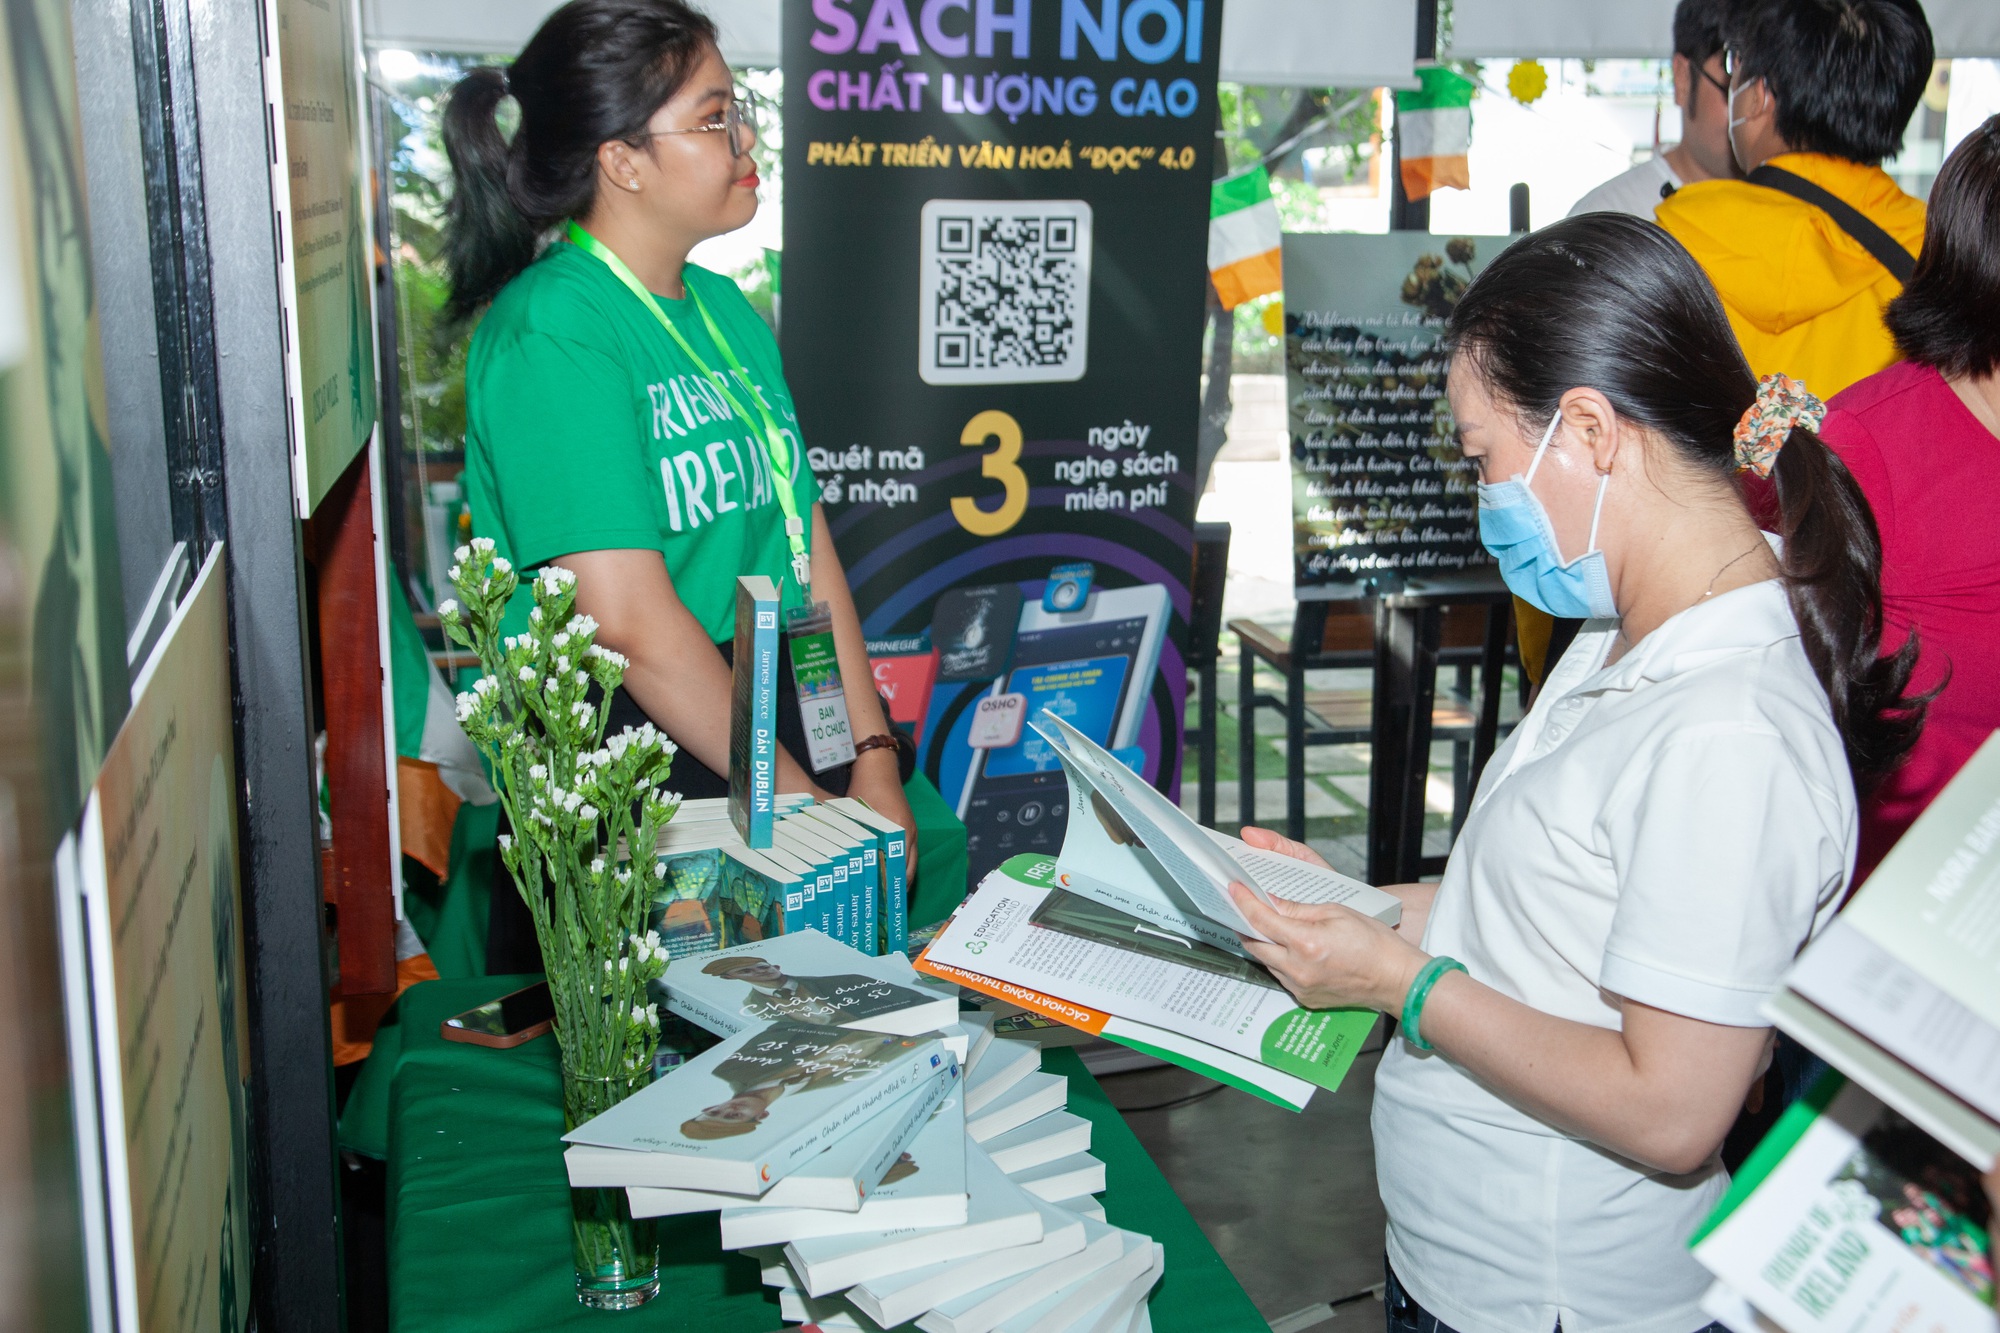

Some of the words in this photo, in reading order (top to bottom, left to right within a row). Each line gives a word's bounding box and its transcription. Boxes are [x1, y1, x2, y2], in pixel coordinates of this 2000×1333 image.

[807, 60, 929, 111] CHẤT
[942, 72, 1098, 123] LƯỢNG
[1110, 77, 1199, 117] CAO
[807, 136, 876, 166] PHÁT
[881, 135, 951, 167] TRIỂN
[958, 140, 1015, 169] VĂN
[1019, 140, 1073, 169] HOÁ
[1158, 146, 1196, 169] 4.0
[1088, 419, 1151, 452] ngày
[807, 445, 872, 472] Quét
[878, 447, 924, 471] mã
[950, 410, 1029, 537] 3
[1055, 457, 1116, 484] nghe
[1122, 450, 1178, 475] sách
[848, 477, 918, 508] nhận
[1065, 481, 1124, 511] miễn
[1130, 480, 1167, 511] phí
[865, 637, 921, 652] ARNEGIE
[762, 648, 772, 685] James
[761, 687, 772, 720] Joyce
[818, 705, 835, 721] BAN
[981, 697, 1017, 712] OSHO
[756, 729, 768, 754] DÂN
[755, 760, 770, 813] DUBLIN
[864, 885, 873, 919] James
[893, 876, 902, 909] James
[836, 902, 845, 937] James
[851, 894, 859, 928] James
[893, 911, 902, 941] Joyce
[973, 897, 1011, 938] EDUCATION
[983, 927, 995, 941] IN
[991, 899, 1021, 933] IRELAND
[1113, 893, 1130, 905] Joyce
[1136, 903, 1162, 918] Chân
[1163, 912, 1188, 928] dung
[1189, 923, 1218, 940] chàng
[1219, 934, 1243, 949] nghệ
[864, 921, 873, 951] Joyce
[739, 995, 829, 1018] Chân
[835, 978, 888, 995] dung
[803, 997, 860, 1018] nghệ
[867, 987, 892, 999] sĩ
[1001, 983, 1036, 1001] ĐỘNG
[1033, 994, 1068, 1013] HOẠT
[1065, 1007, 1090, 1022] CÁC
[1320, 1048, 1336, 1067] JAMES
[1330, 1032, 1345, 1050] JOYCE
[822, 1122, 841, 1138] Chân
[842, 1106, 861, 1124] dung
[1791, 1227, 1872, 1322] IRELAND
